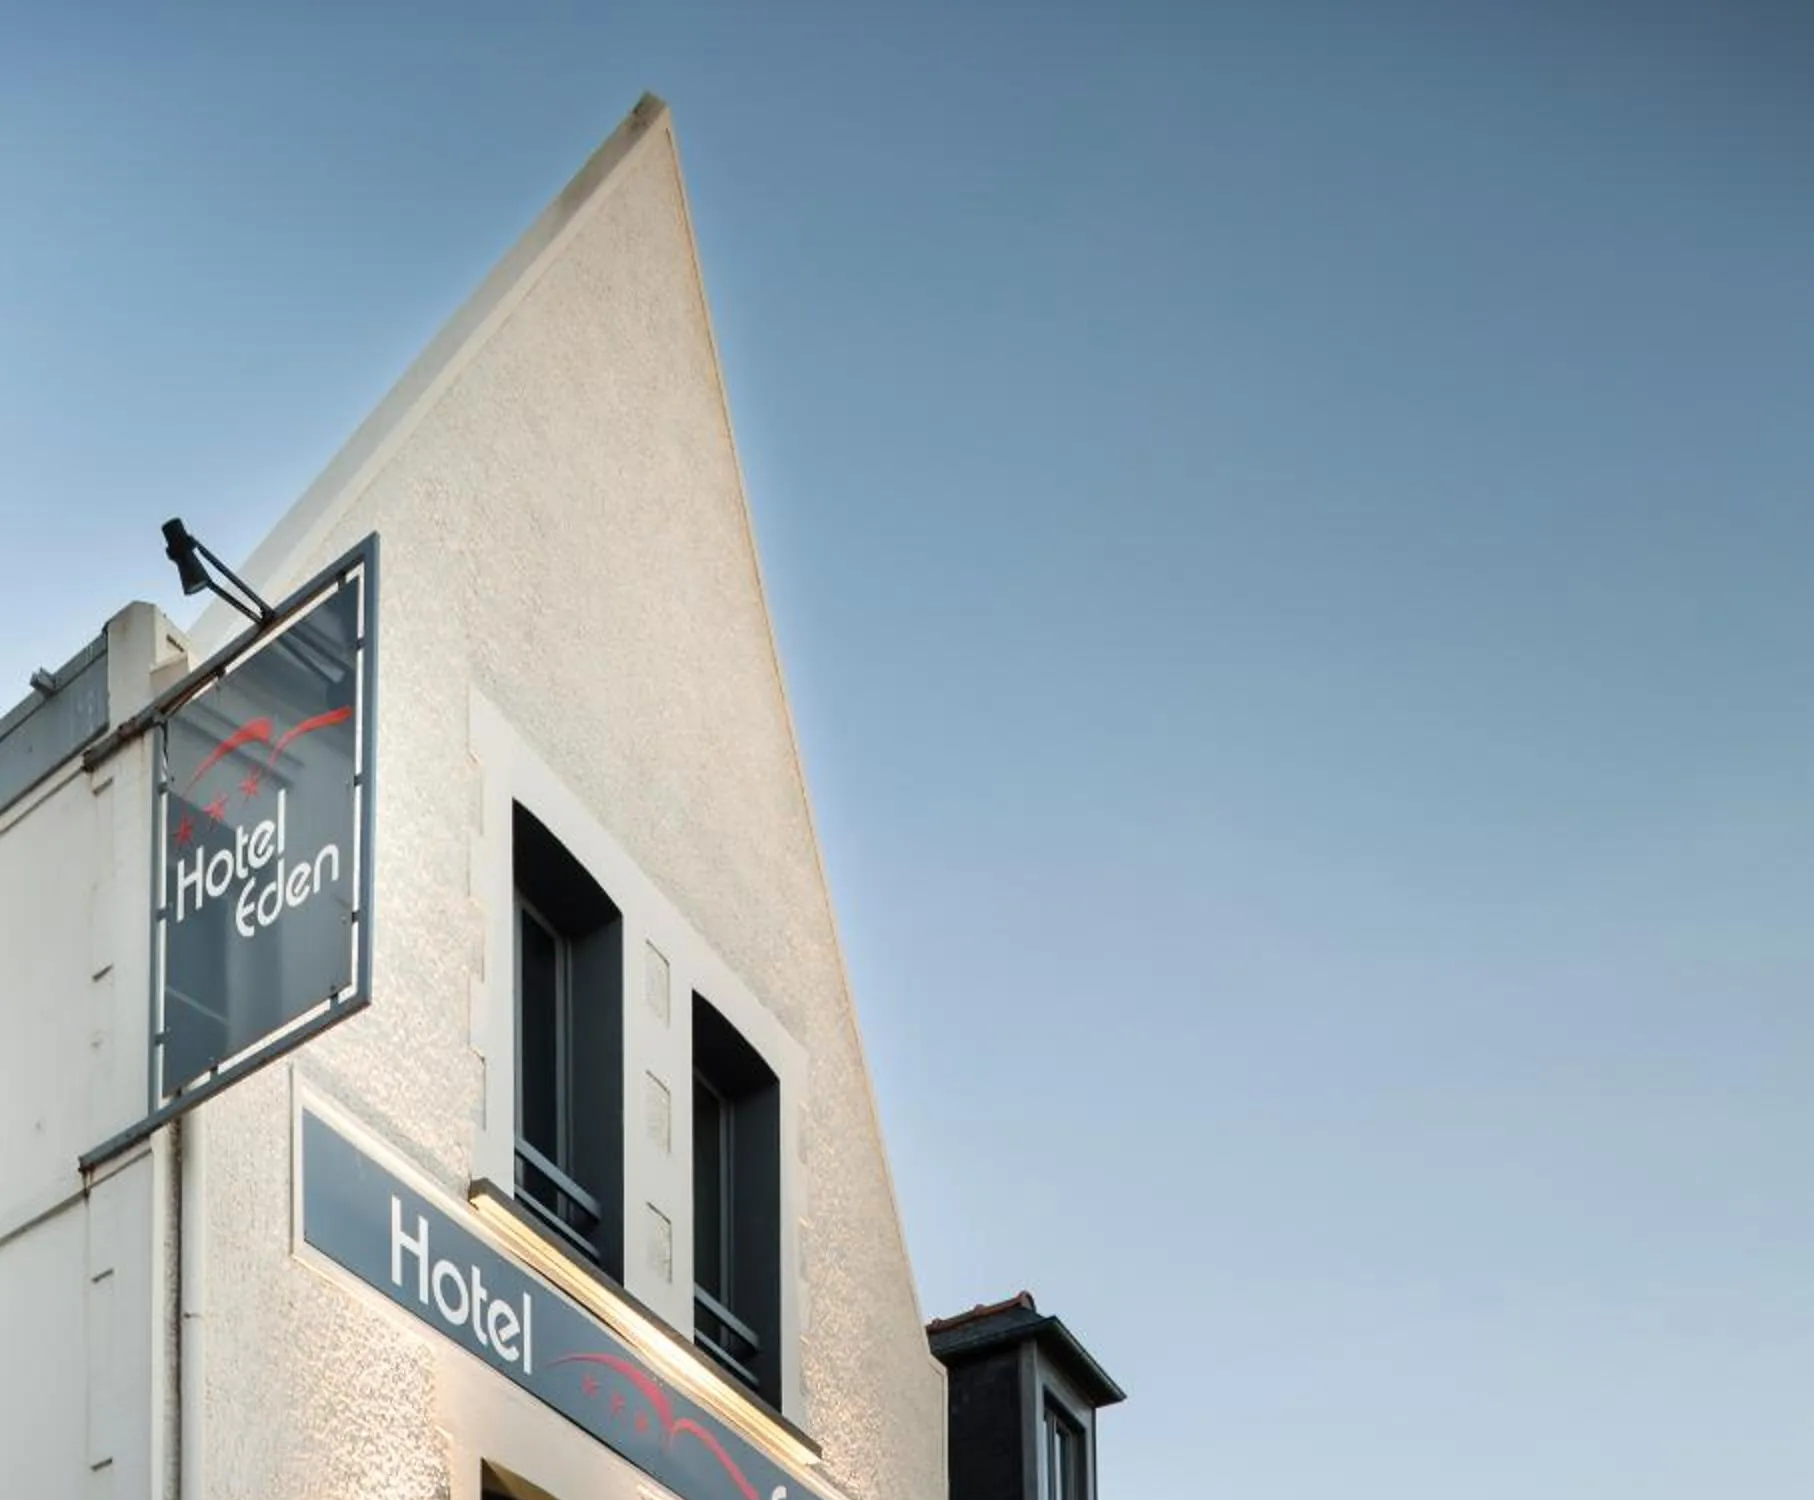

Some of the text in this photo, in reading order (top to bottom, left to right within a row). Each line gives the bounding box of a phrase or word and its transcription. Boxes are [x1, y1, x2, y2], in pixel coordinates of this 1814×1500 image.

[176, 789, 286, 922] Hotel
[236, 844, 339, 937] Eden
[391, 1194, 532, 1375] Hotel
